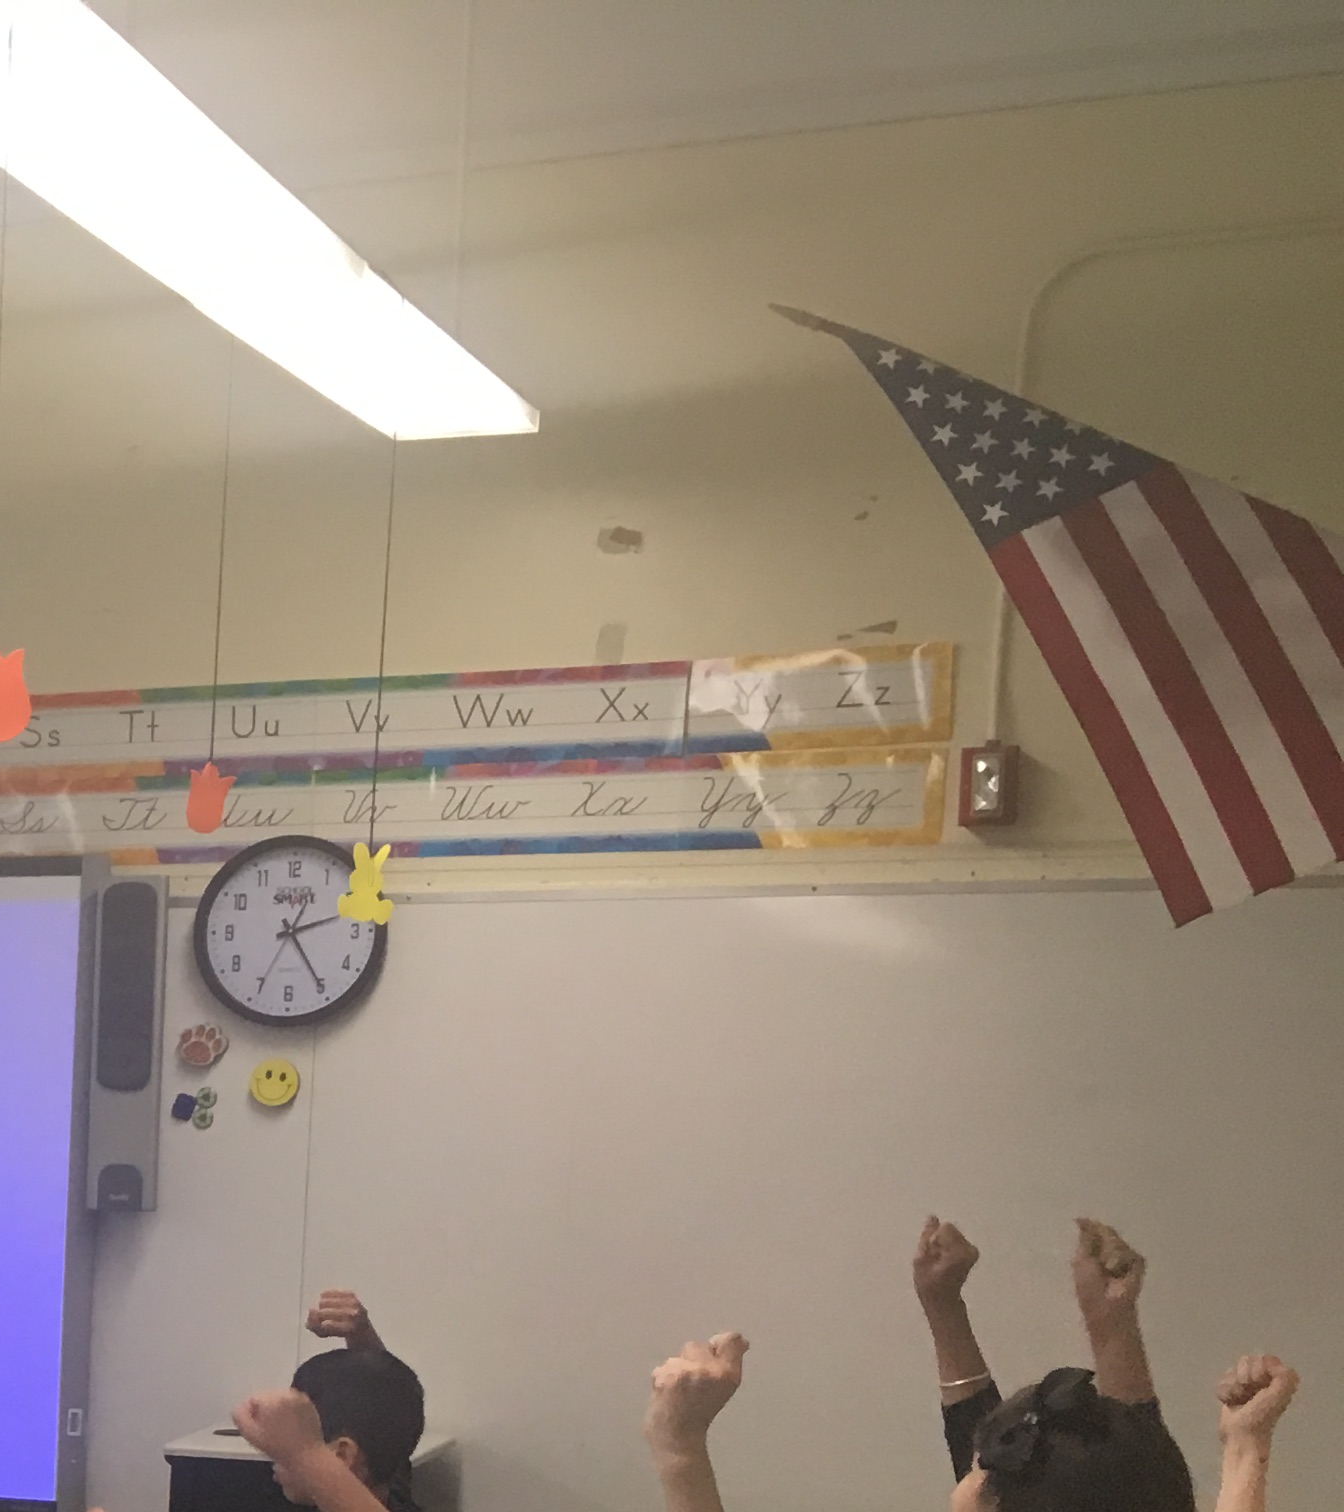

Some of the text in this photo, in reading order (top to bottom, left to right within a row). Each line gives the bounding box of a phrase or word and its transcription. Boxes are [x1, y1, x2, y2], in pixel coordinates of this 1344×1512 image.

[19, 715, 60, 749] Ss
[119, 710, 158, 743] Tt
[230, 706, 280, 739] Uu
[346, 699, 389, 734] Vv
[453, 693, 533, 729] Ww
[594, 687, 649, 723] Xx
[733, 679, 782, 730] Yy
[835, 671, 891, 709] Zz
[440, 786, 530, 821] Ww
[571, 781, 649, 816] Xx
[257, 869, 269, 887] 11
[287, 860, 302, 878] 12
[324, 868, 330, 886] 1
[233, 893, 247, 911] 10
[224, 924, 234, 941] 9
[350, 923, 359, 939] 3
[231, 954, 241, 972] 8
[341, 954, 350, 970] 4
[283, 985, 294, 1002] 6
